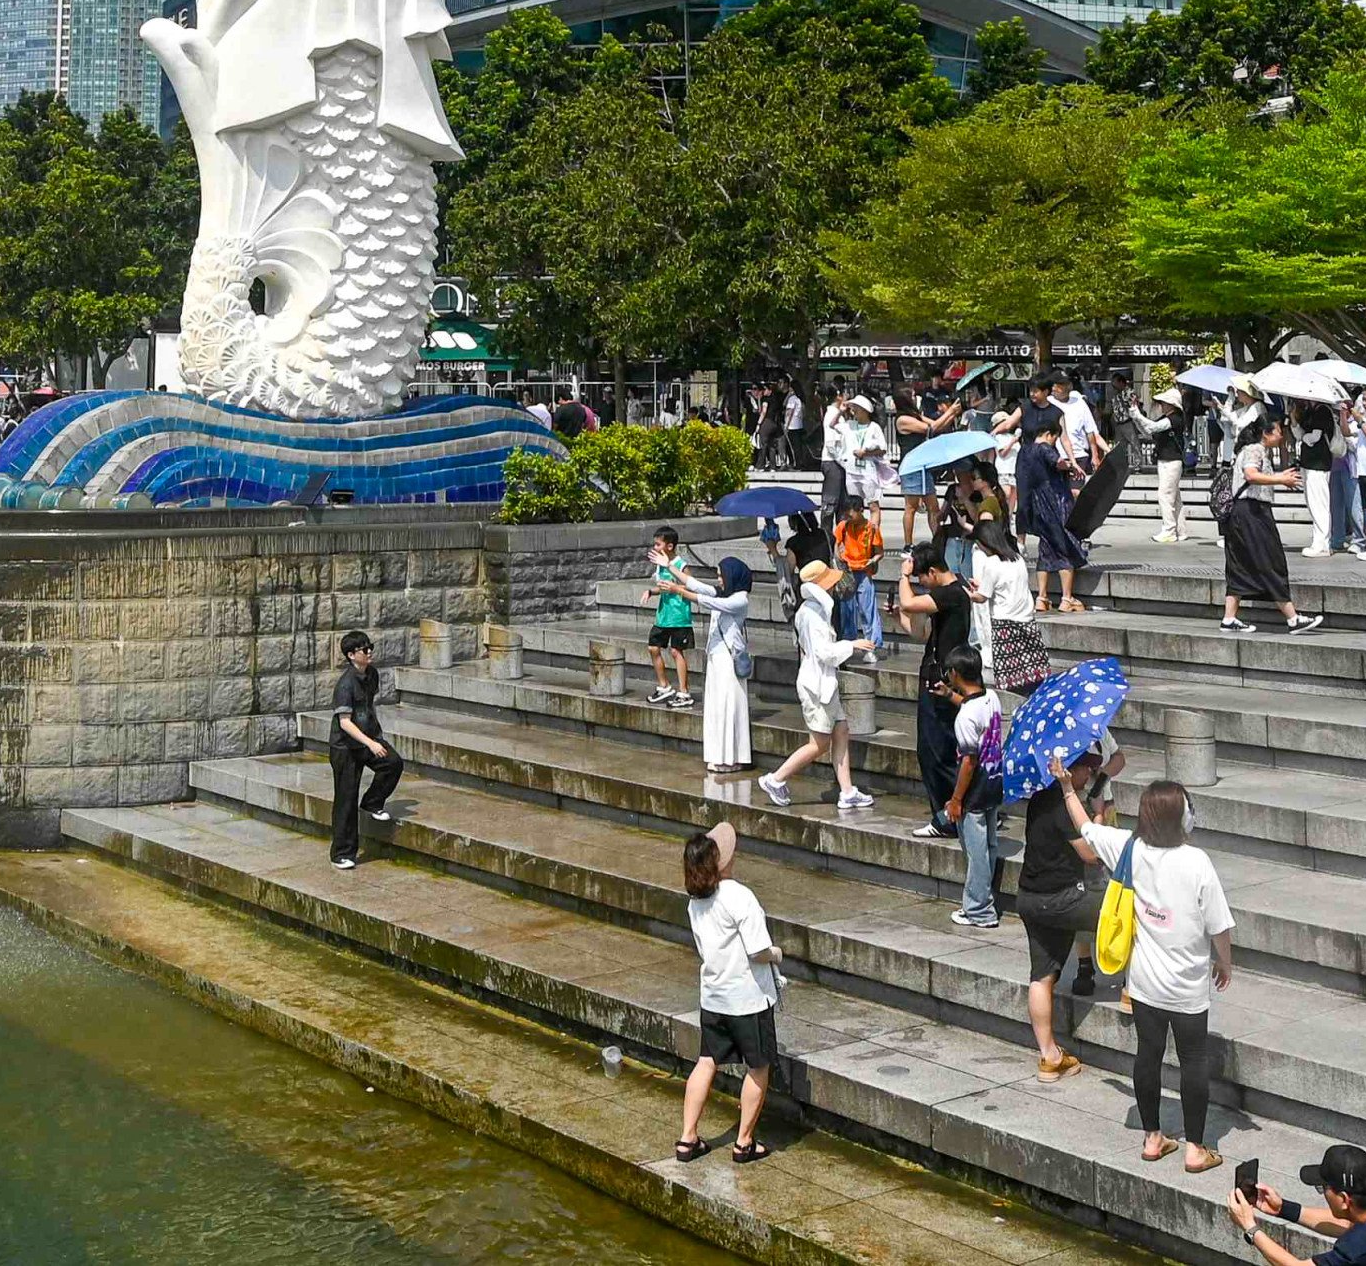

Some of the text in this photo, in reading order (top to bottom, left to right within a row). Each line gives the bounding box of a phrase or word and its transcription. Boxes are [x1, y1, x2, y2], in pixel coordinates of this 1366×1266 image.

[975, 345, 1032, 357] GELATO
[1132, 344, 1195, 357] SKEWERS
[415, 360, 486, 372] MOS BURGER
